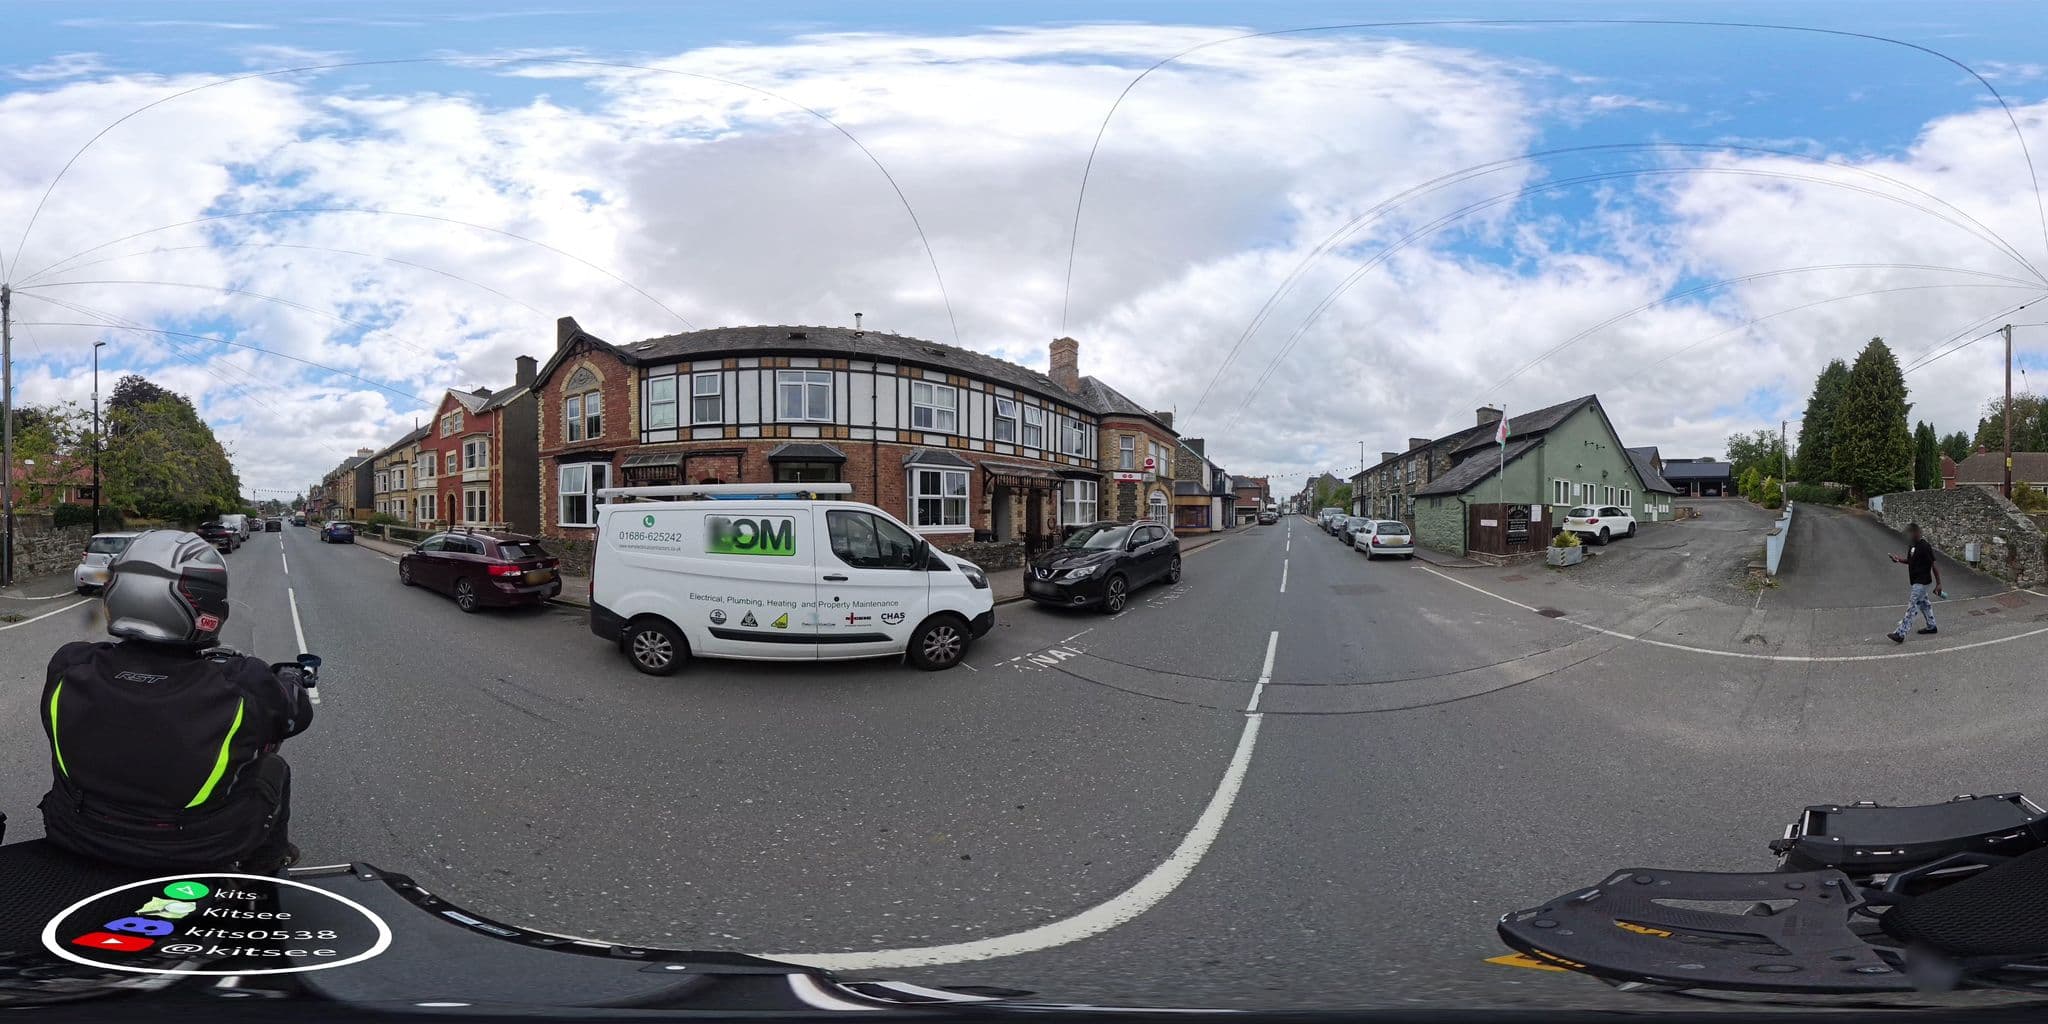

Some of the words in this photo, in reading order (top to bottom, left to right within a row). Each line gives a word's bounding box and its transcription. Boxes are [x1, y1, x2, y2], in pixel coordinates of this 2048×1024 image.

[619, 531, 682, 543] 01686-625242
[706, 517, 792, 550] OM
[689, 592, 725, 604] Electrical,
[726, 596, 765, 607] Plumbing,
[767, 599, 797, 609] Heating
[818, 600, 851, 609] Property
[852, 600, 899, 608] Maintenance
[881, 612, 906, 620] CHAS
[114, 670, 169, 684] RST
